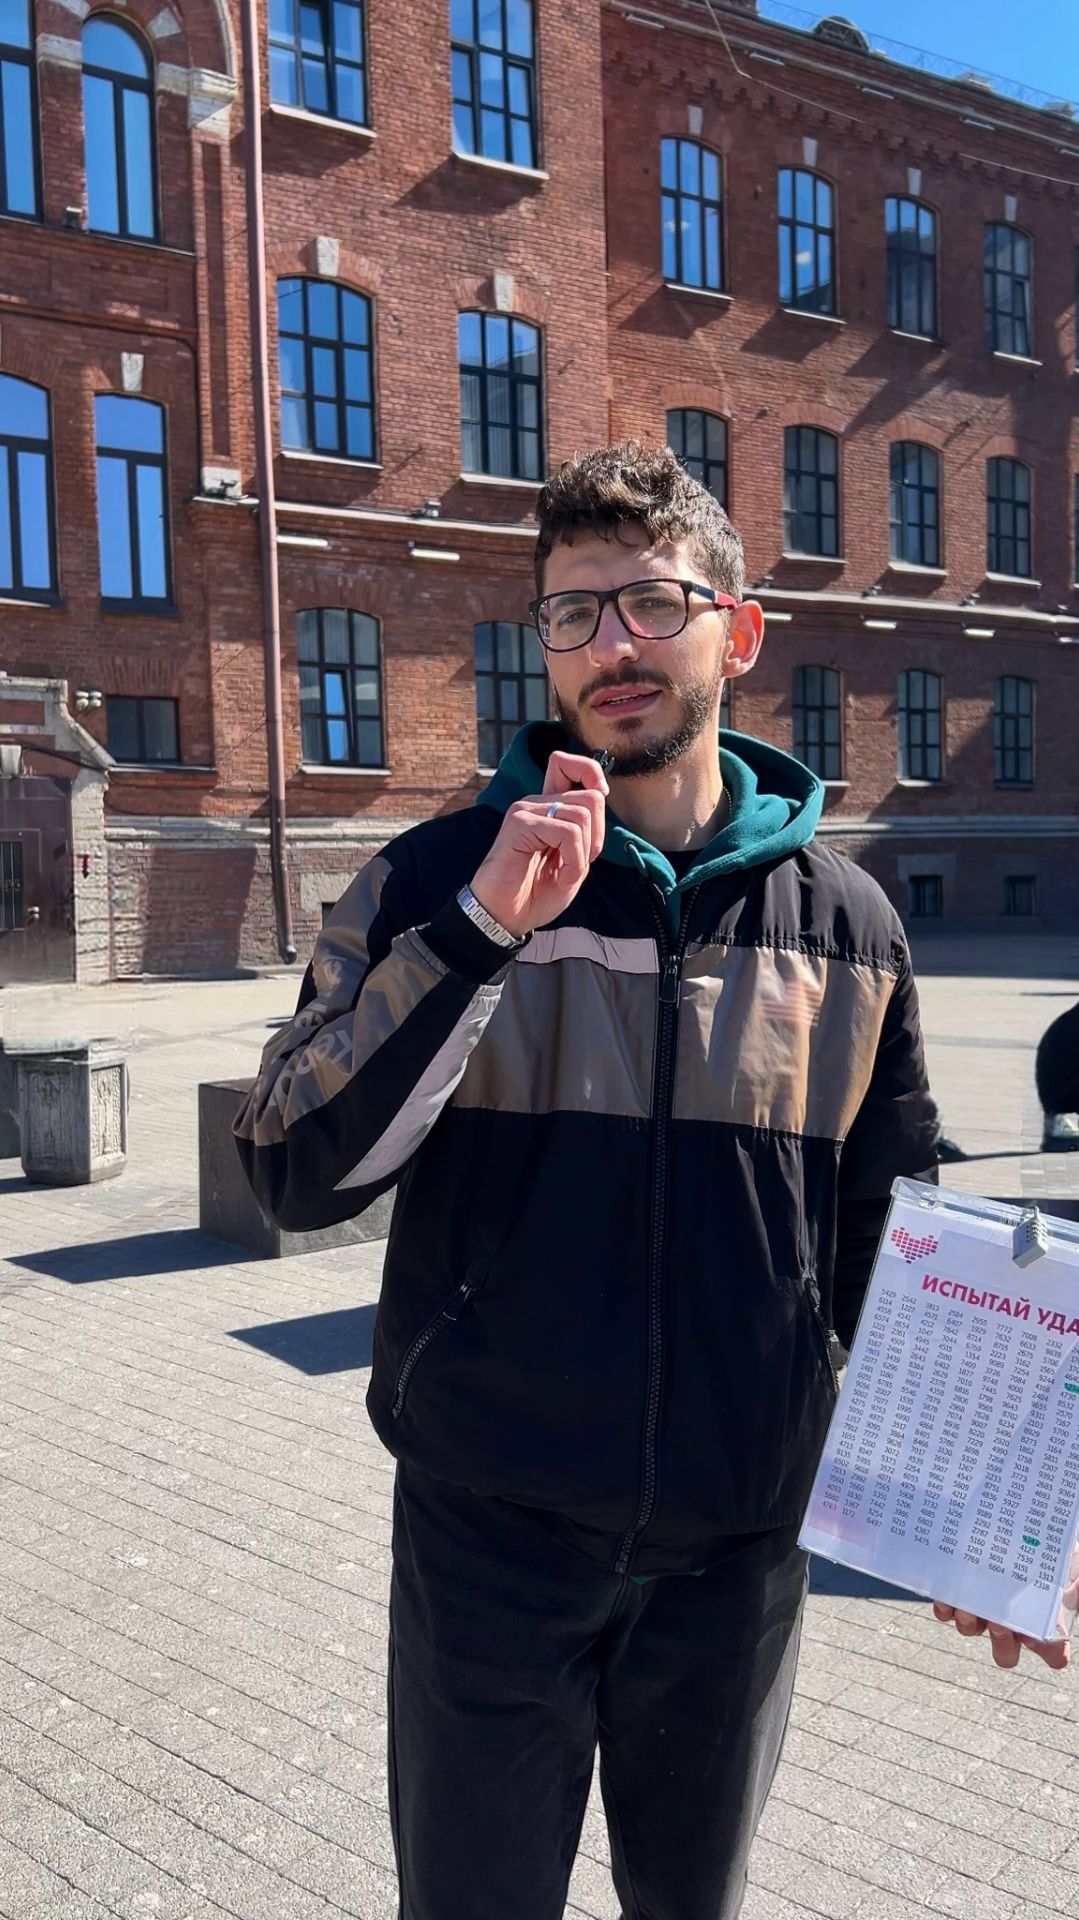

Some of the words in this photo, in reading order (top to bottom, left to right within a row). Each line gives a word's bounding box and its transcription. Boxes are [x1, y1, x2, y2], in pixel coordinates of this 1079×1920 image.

[921, 1274, 1031, 1320] ИСПЫТАЙ
[972, 1316, 988, 1326] 2955
[1016, 1357, 1031, 1368] 3162
[1010, 1375, 1026, 1385] 7084
[1007, 1384, 1024, 1394] 4000
[1027, 1418, 1044, 1429] 2103
[1030, 1410, 1045, 1420] 9311
[1056, 1418, 1071, 1428] 7167
[1041, 1462, 1058, 1473] 2307
[952, 1490, 967, 1500] 4212
[1000, 1507, 1016, 1518] 1202
[1020, 1545, 1036, 1555] 4123
[1017, 1553, 1034, 1565] 7539
